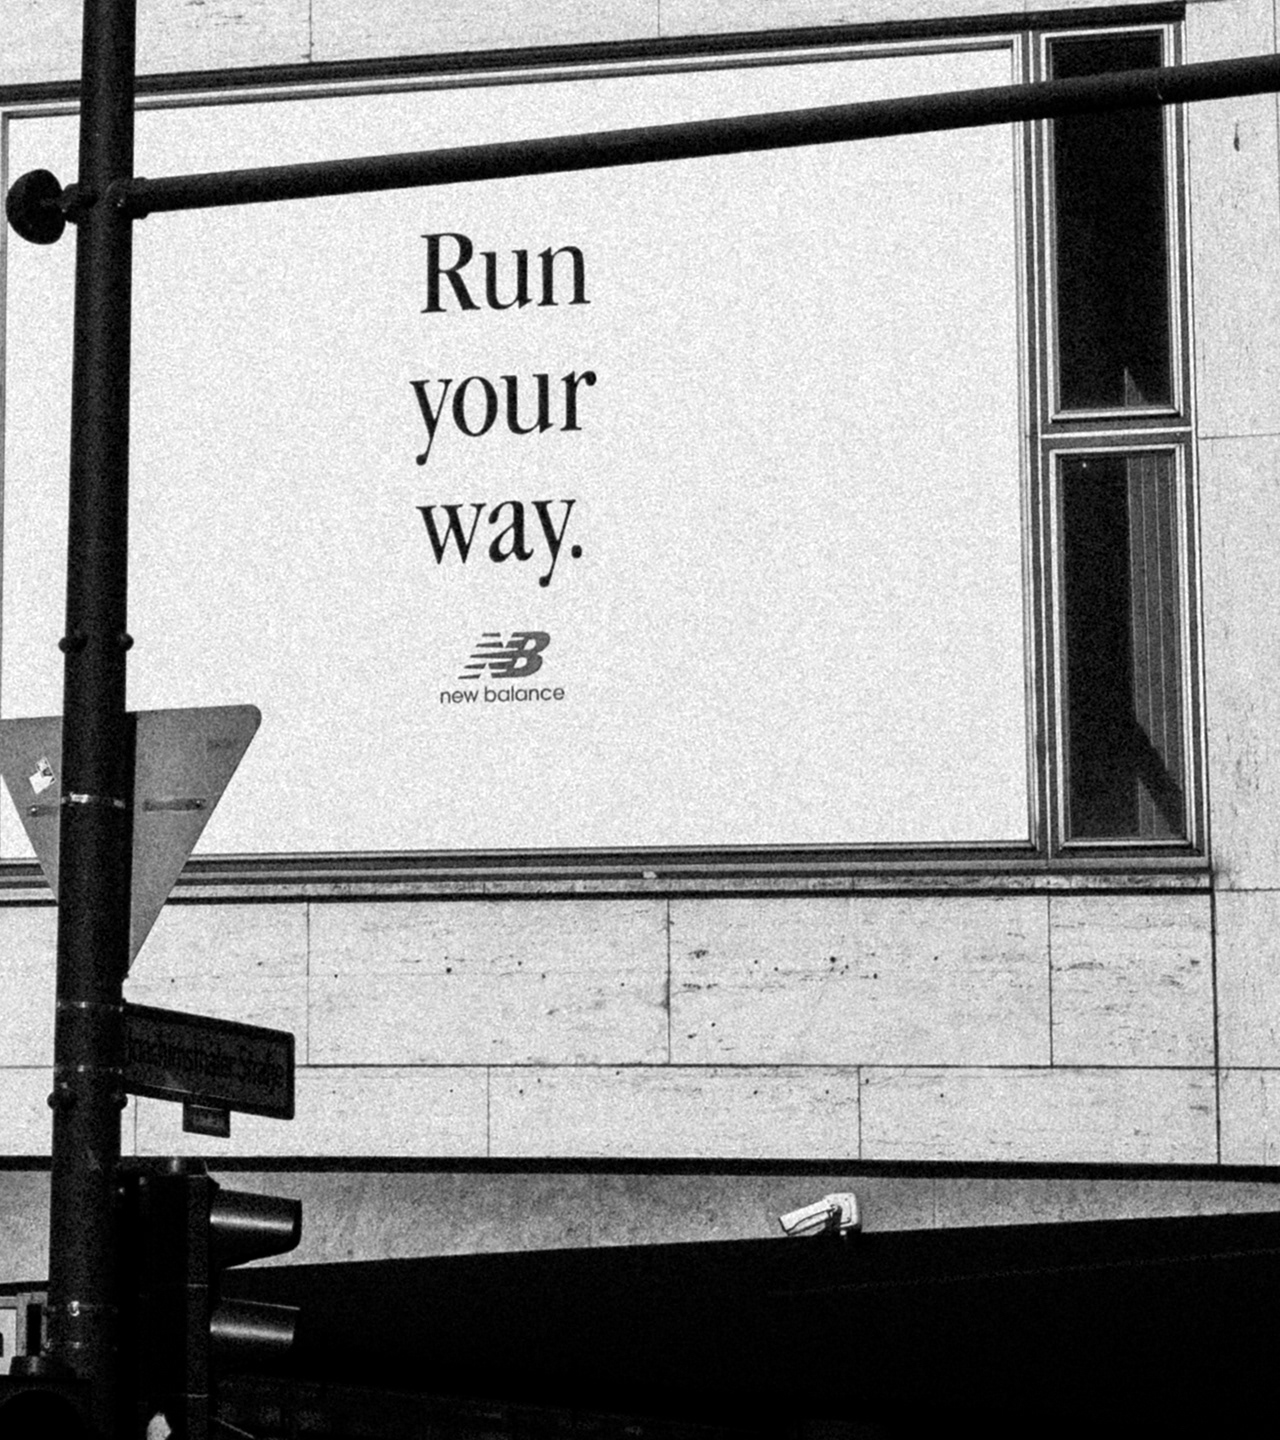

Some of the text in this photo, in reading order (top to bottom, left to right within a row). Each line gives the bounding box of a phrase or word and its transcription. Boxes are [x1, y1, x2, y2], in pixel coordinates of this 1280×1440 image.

[420, 232, 591, 313] Run
[409, 369, 597, 466] your
[415, 497, 584, 588] way.
[439, 683, 566, 704] new balance
